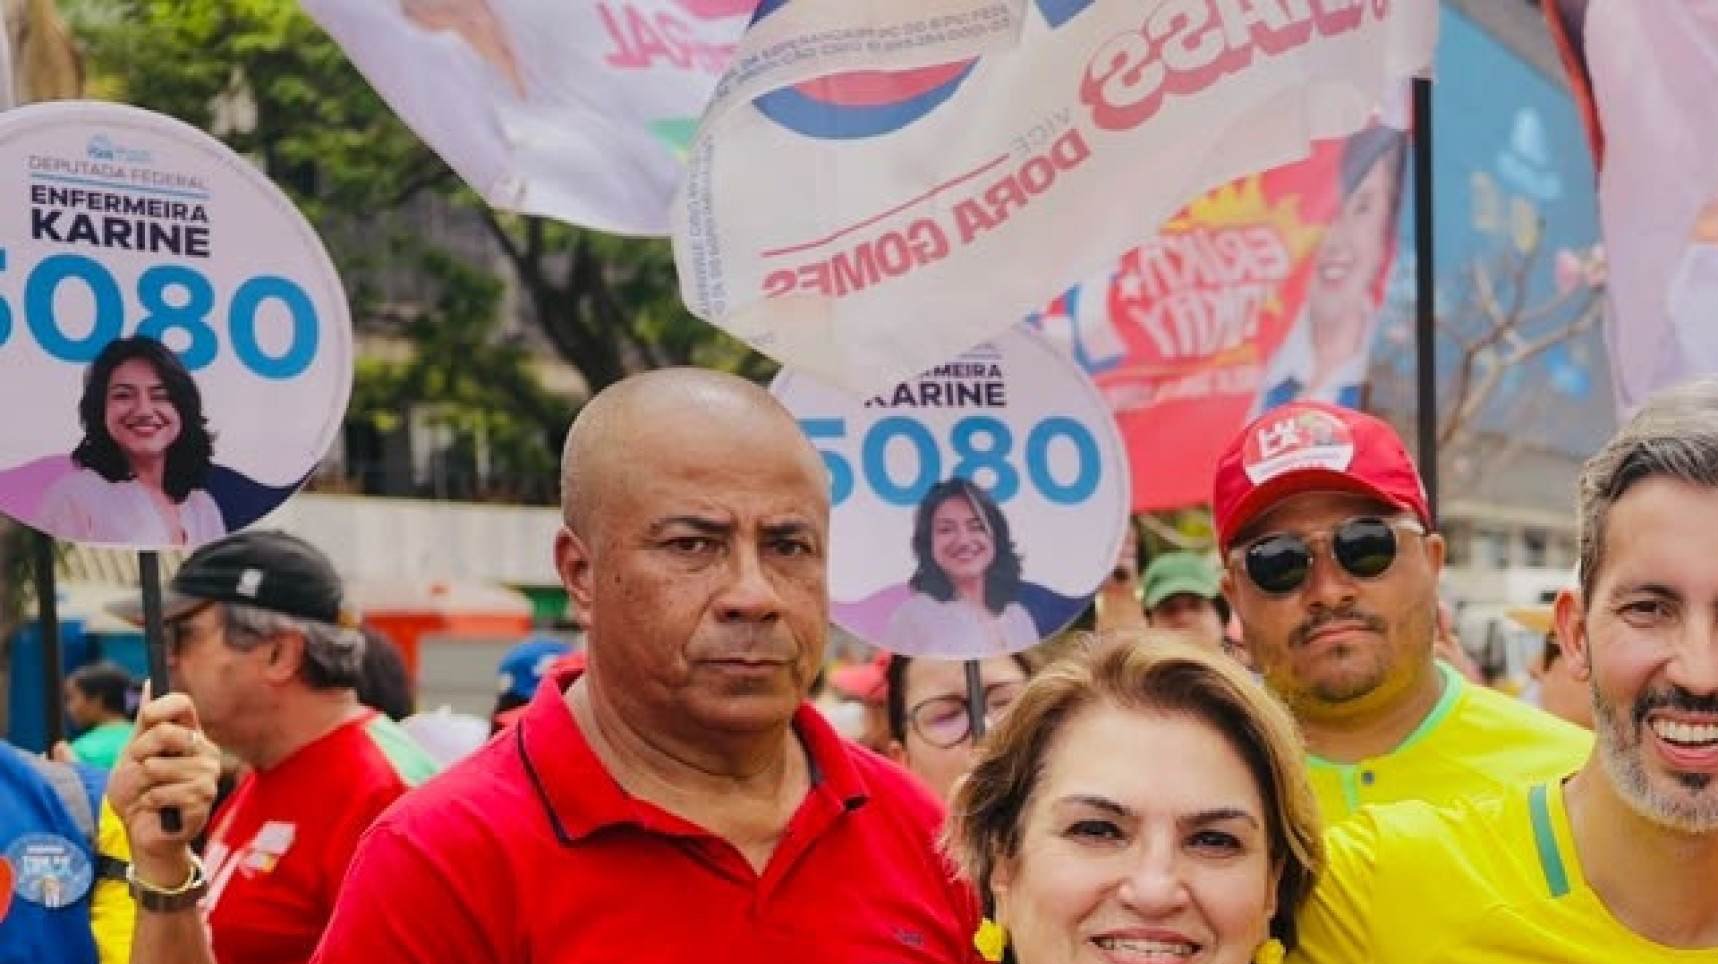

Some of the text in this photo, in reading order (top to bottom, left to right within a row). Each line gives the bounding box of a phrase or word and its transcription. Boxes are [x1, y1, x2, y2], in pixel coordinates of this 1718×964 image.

[30, 184, 208, 223] ENFERMEIRA
[31, 208, 210, 258] KARINE
[0, 247, 320, 380] 080
